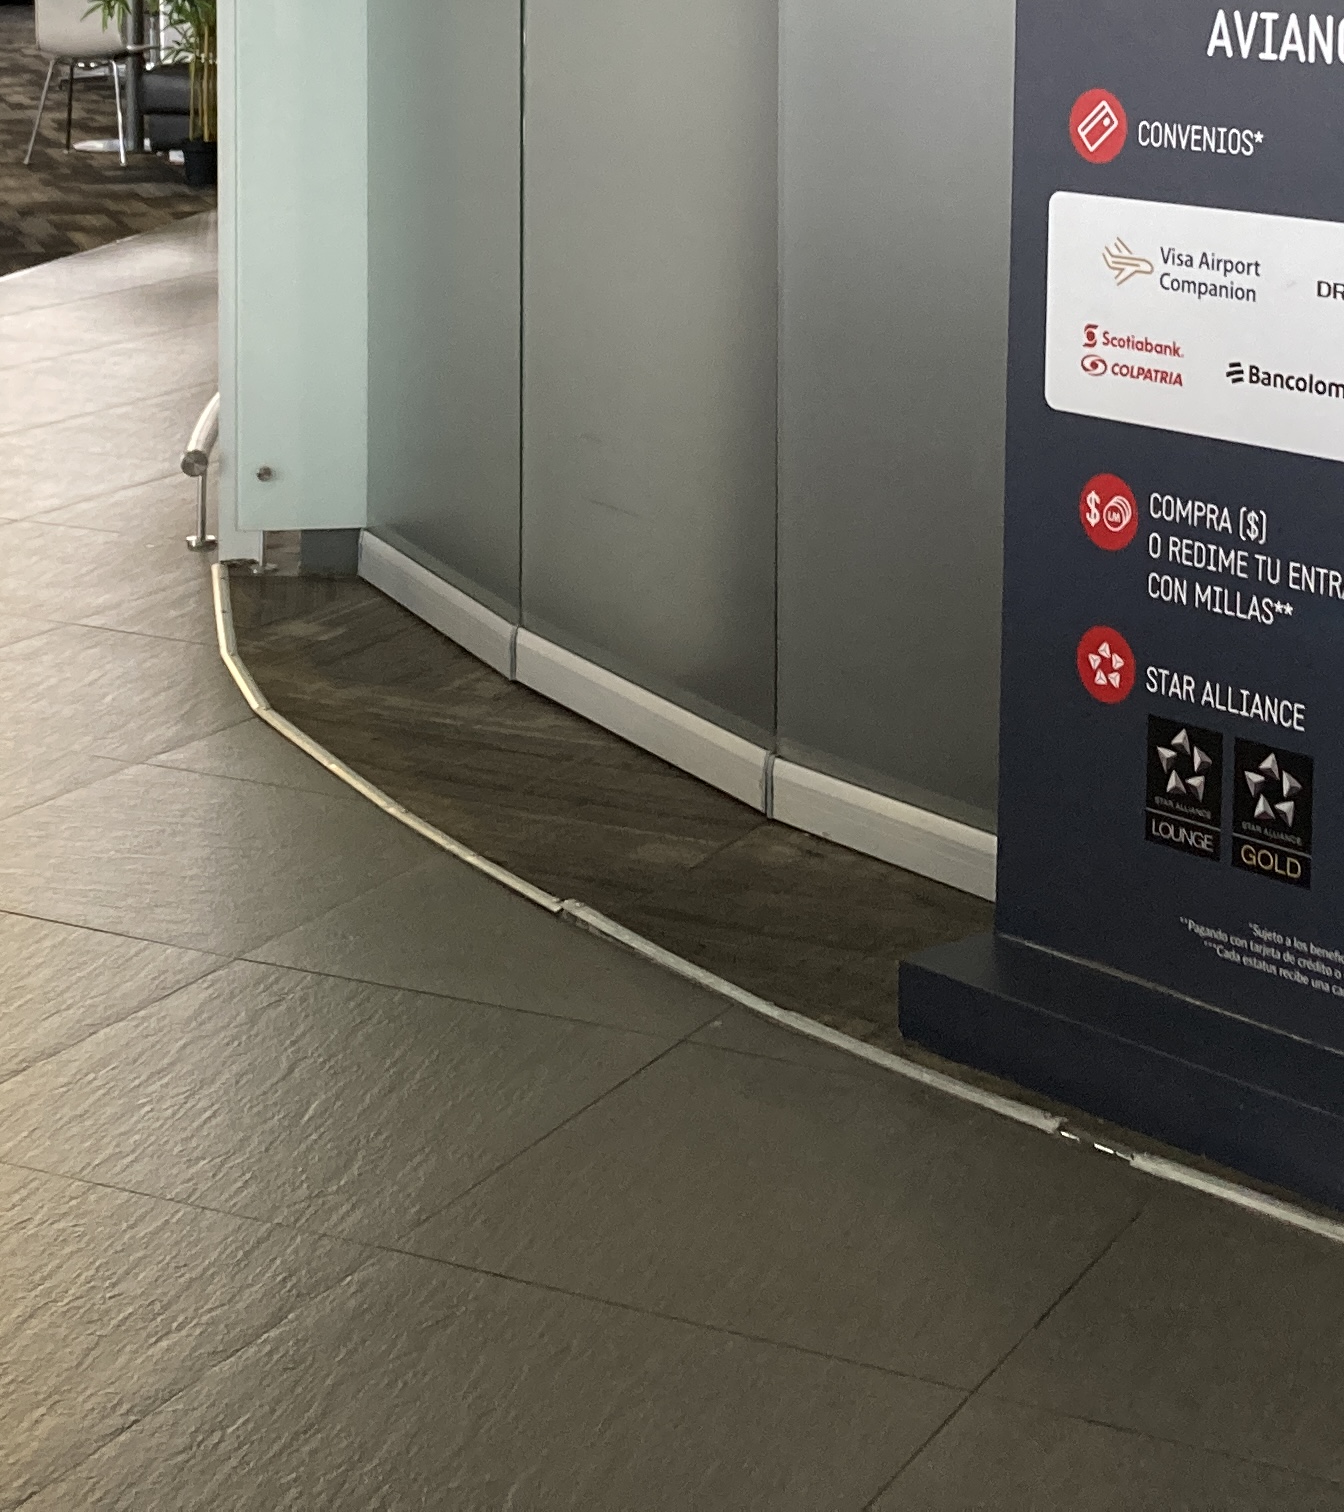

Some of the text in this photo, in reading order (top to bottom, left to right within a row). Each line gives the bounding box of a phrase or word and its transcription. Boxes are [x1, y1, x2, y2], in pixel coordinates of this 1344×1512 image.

[1159, 246, 1261, 277] Visa Airport
[1159, 273, 1257, 303] Companion
[1102, 330, 1182, 358] Scotiabank
[1111, 362, 1184, 387] COLPATRIA
[1149, 492, 1233, 534] COMPRA
[1149, 533, 1162, 558] O
[1169, 536, 1249, 579] REDIME
[1254, 555, 1281, 585] TU
[1148, 572, 1187, 605] CON
[1146, 666, 1305, 732] STAR ALLIANCE
[1152, 818, 1214, 853] LOUNGE
[1240, 844, 1302, 879] GOLD
[1229, 935, 1248, 949] con
[1282, 951, 1296, 965] de
